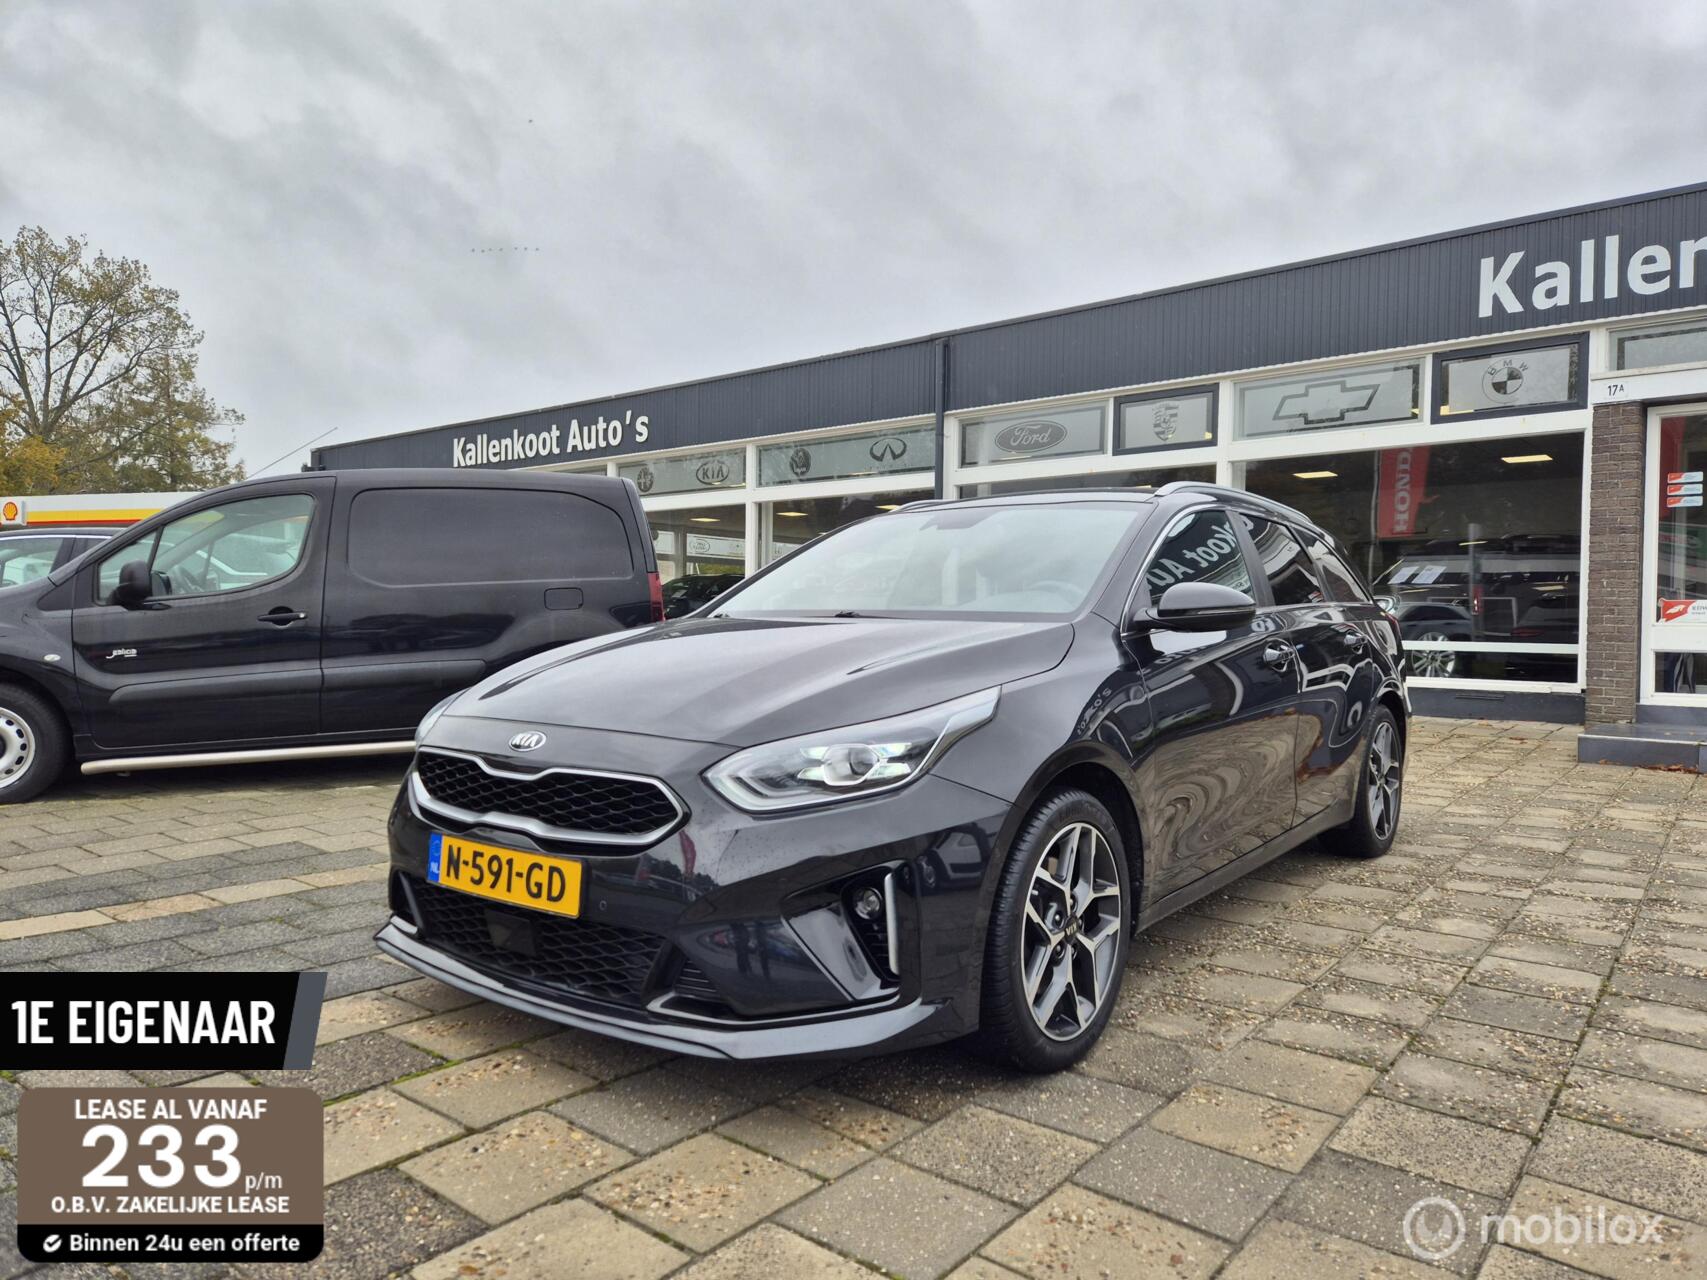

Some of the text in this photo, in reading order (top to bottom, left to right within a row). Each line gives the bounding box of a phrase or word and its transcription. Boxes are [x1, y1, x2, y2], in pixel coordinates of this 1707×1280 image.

[1487, 359, 1528, 376] BMW
[453, 410, 649, 467] Kallenkoot Auto's
[1010, 424, 1051, 446] Ford
[1393, 448, 1411, 532] HOND
[511, 732, 539, 747] KIA
[429, 861, 440, 874] NL
[446, 844, 566, 903] N-591-GD
[1065, 922, 1077, 935] KIA
